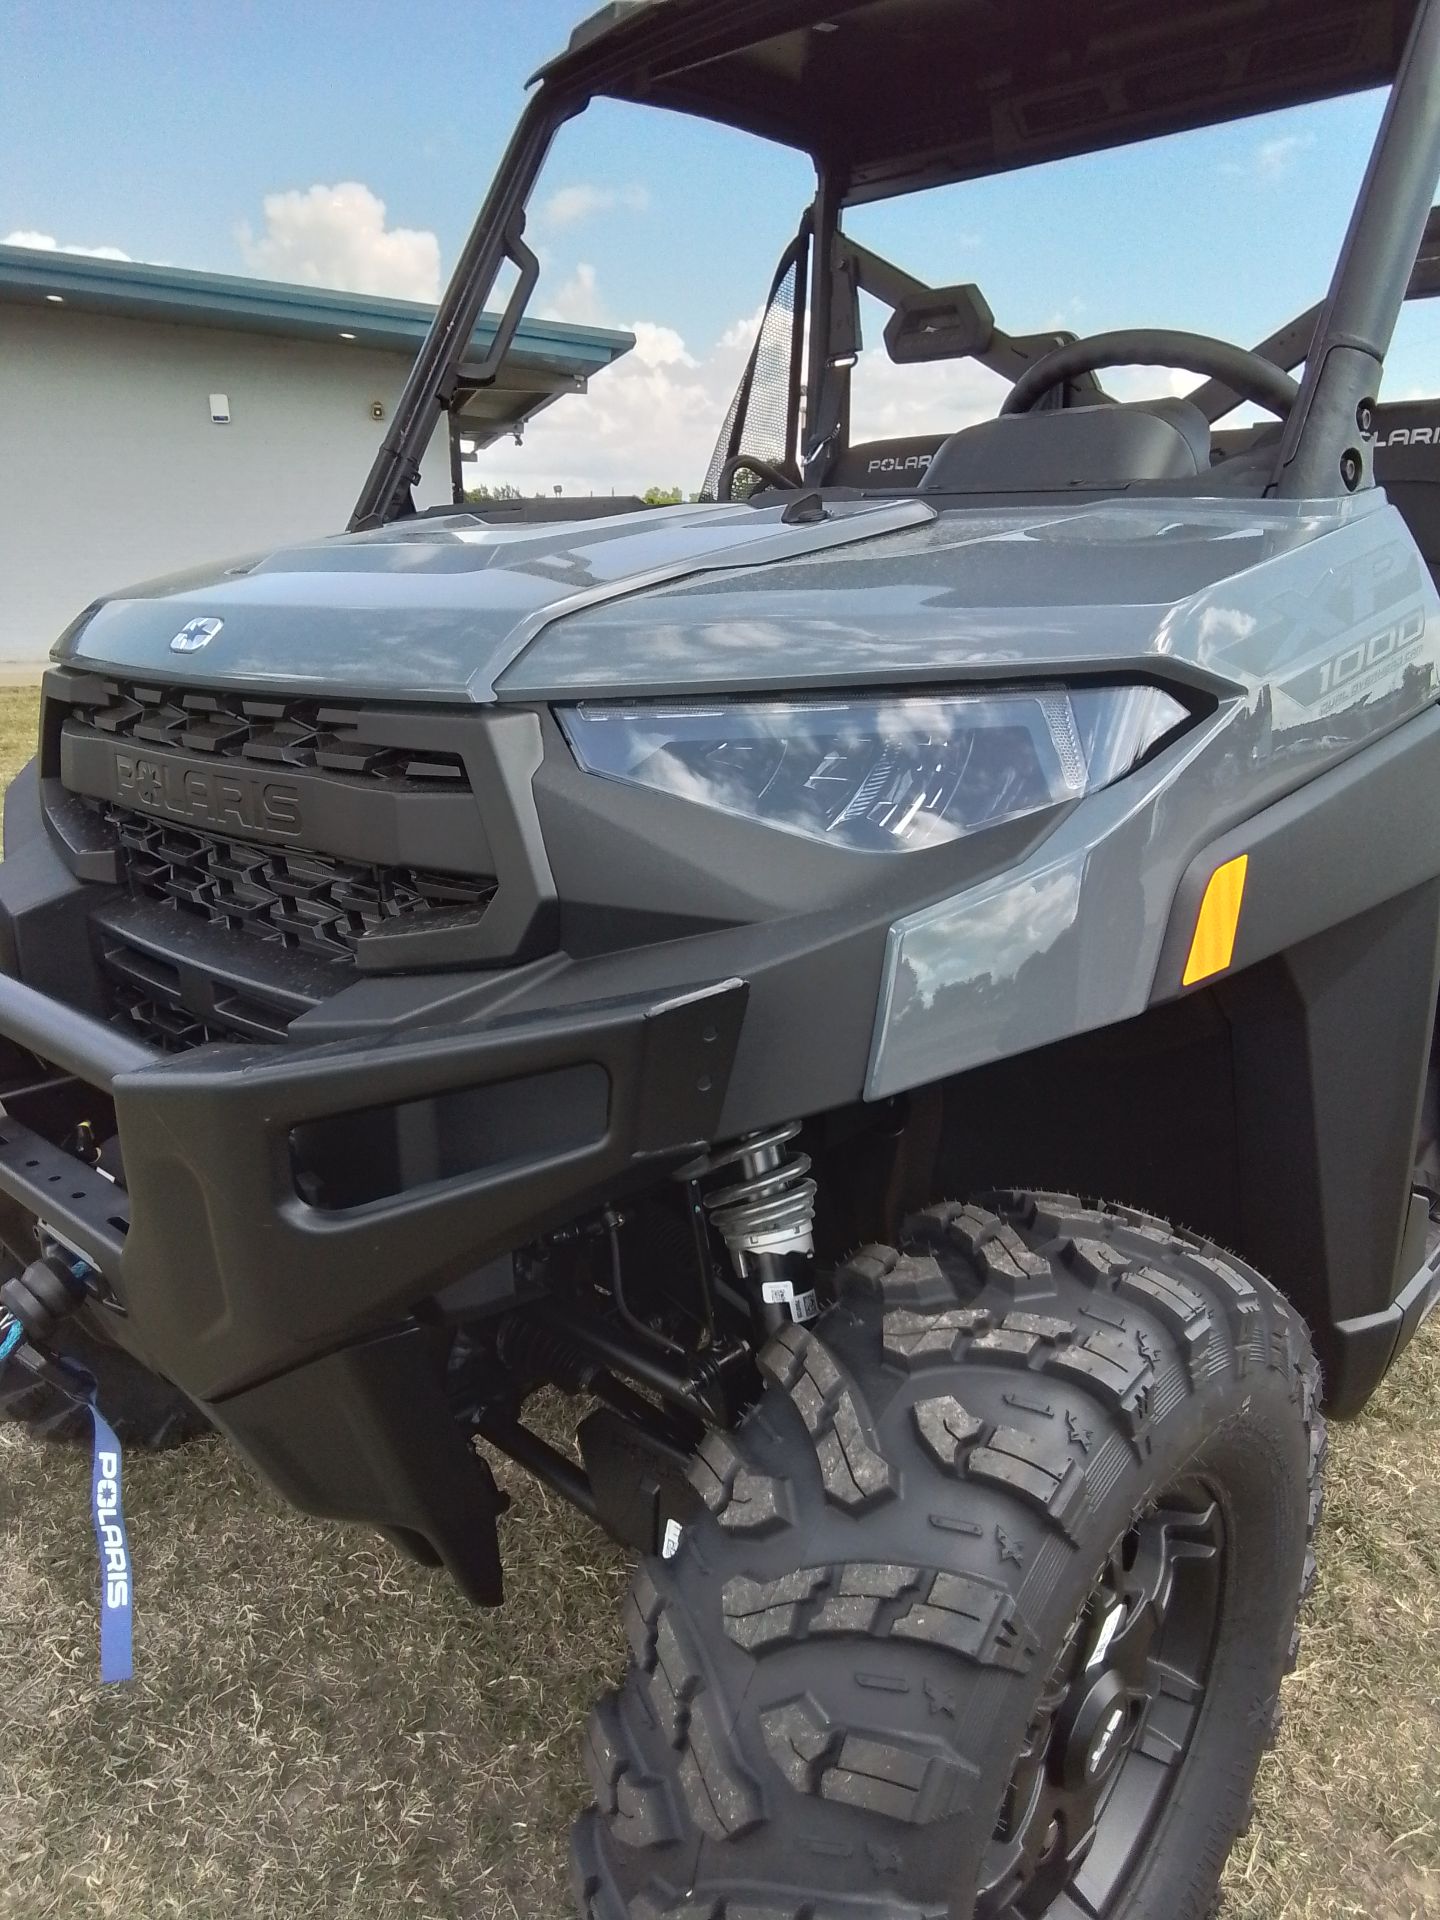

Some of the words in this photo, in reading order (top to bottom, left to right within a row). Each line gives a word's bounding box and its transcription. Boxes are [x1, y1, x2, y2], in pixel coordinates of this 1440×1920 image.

[1319, 604, 1425, 695] 1000
[115, 754, 302, 837] POLARIS
[96, 1451, 129, 1609] POLARIS
